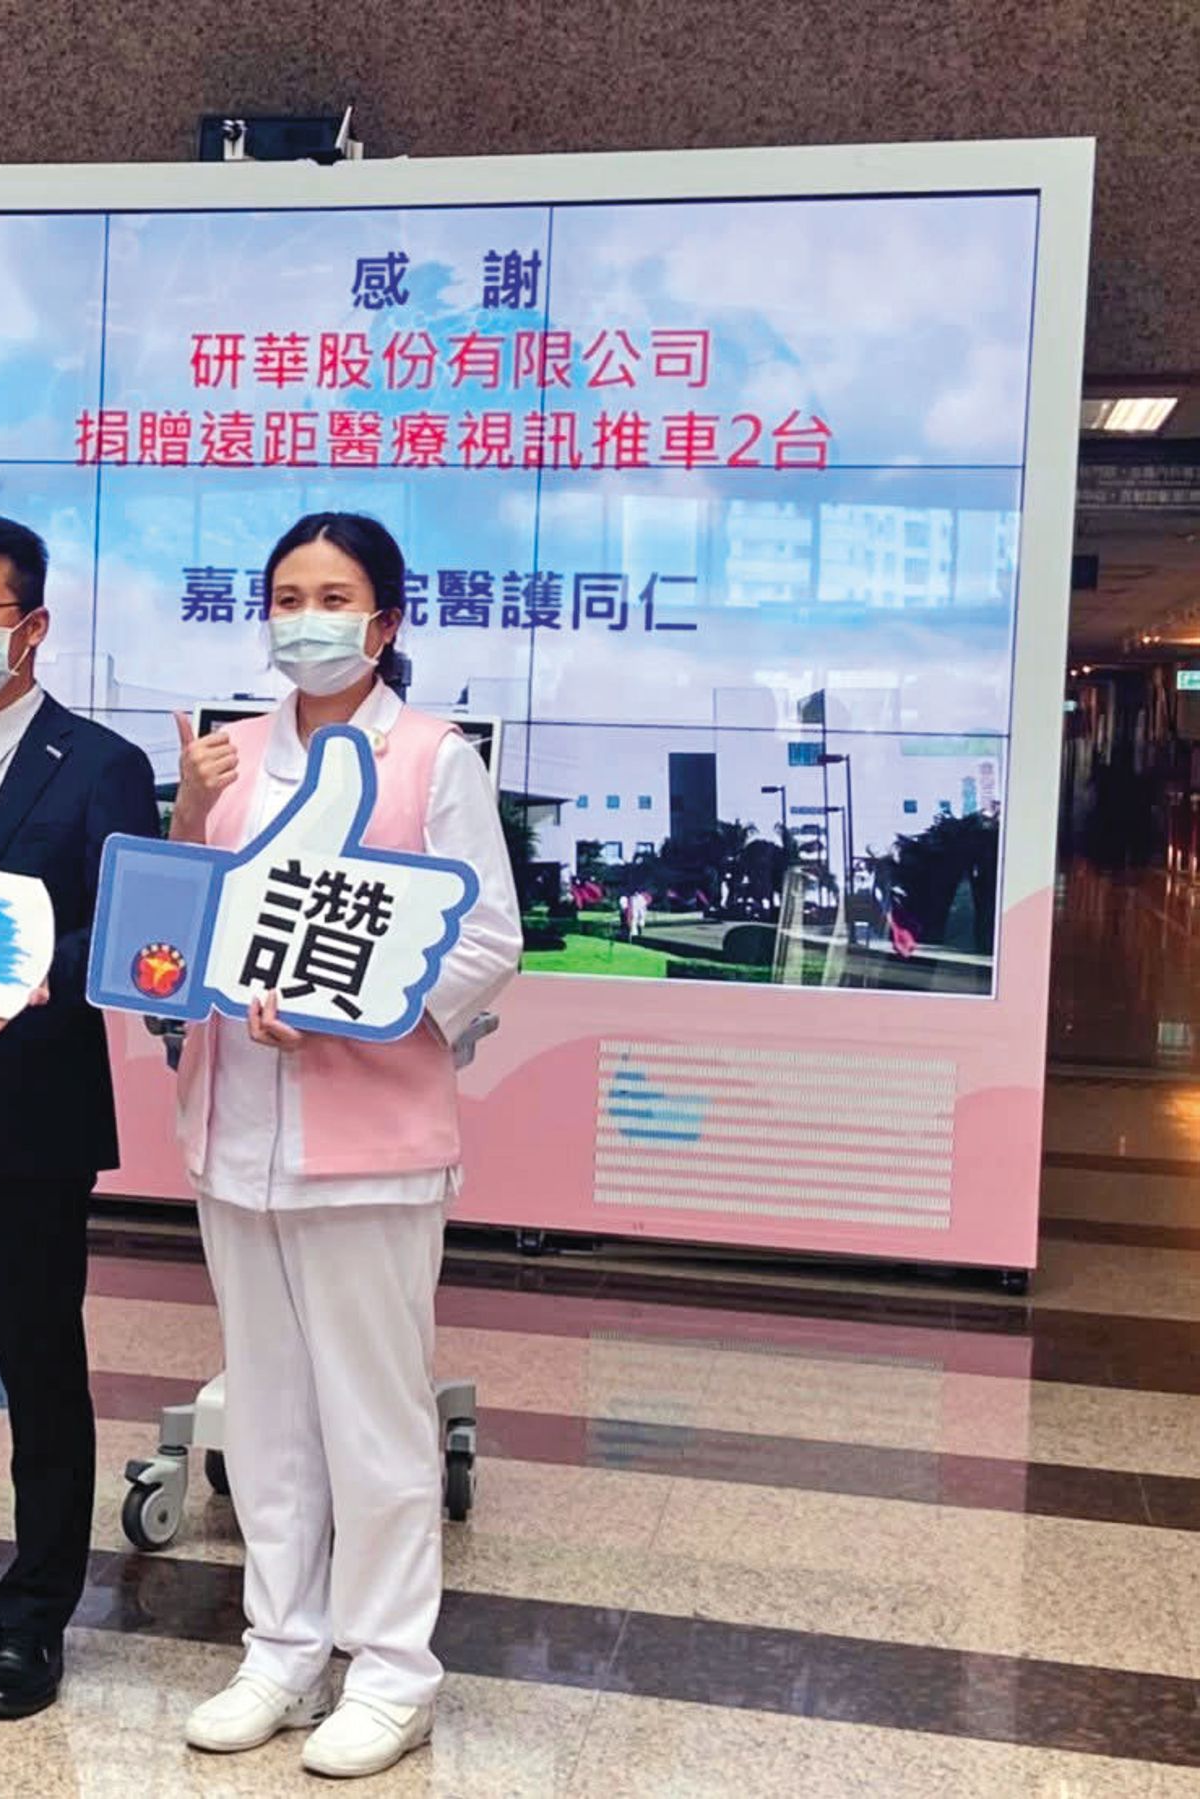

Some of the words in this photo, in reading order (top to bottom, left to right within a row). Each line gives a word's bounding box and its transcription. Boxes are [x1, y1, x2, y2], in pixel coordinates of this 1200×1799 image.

[189, 328, 711, 391] 研華股份有限公司
[74, 407, 834, 472] 捐贈遠距醫療視訊推車2台
[181, 566, 699, 634] 嘉醫護同仁
[239, 860, 394, 1020] 讚
